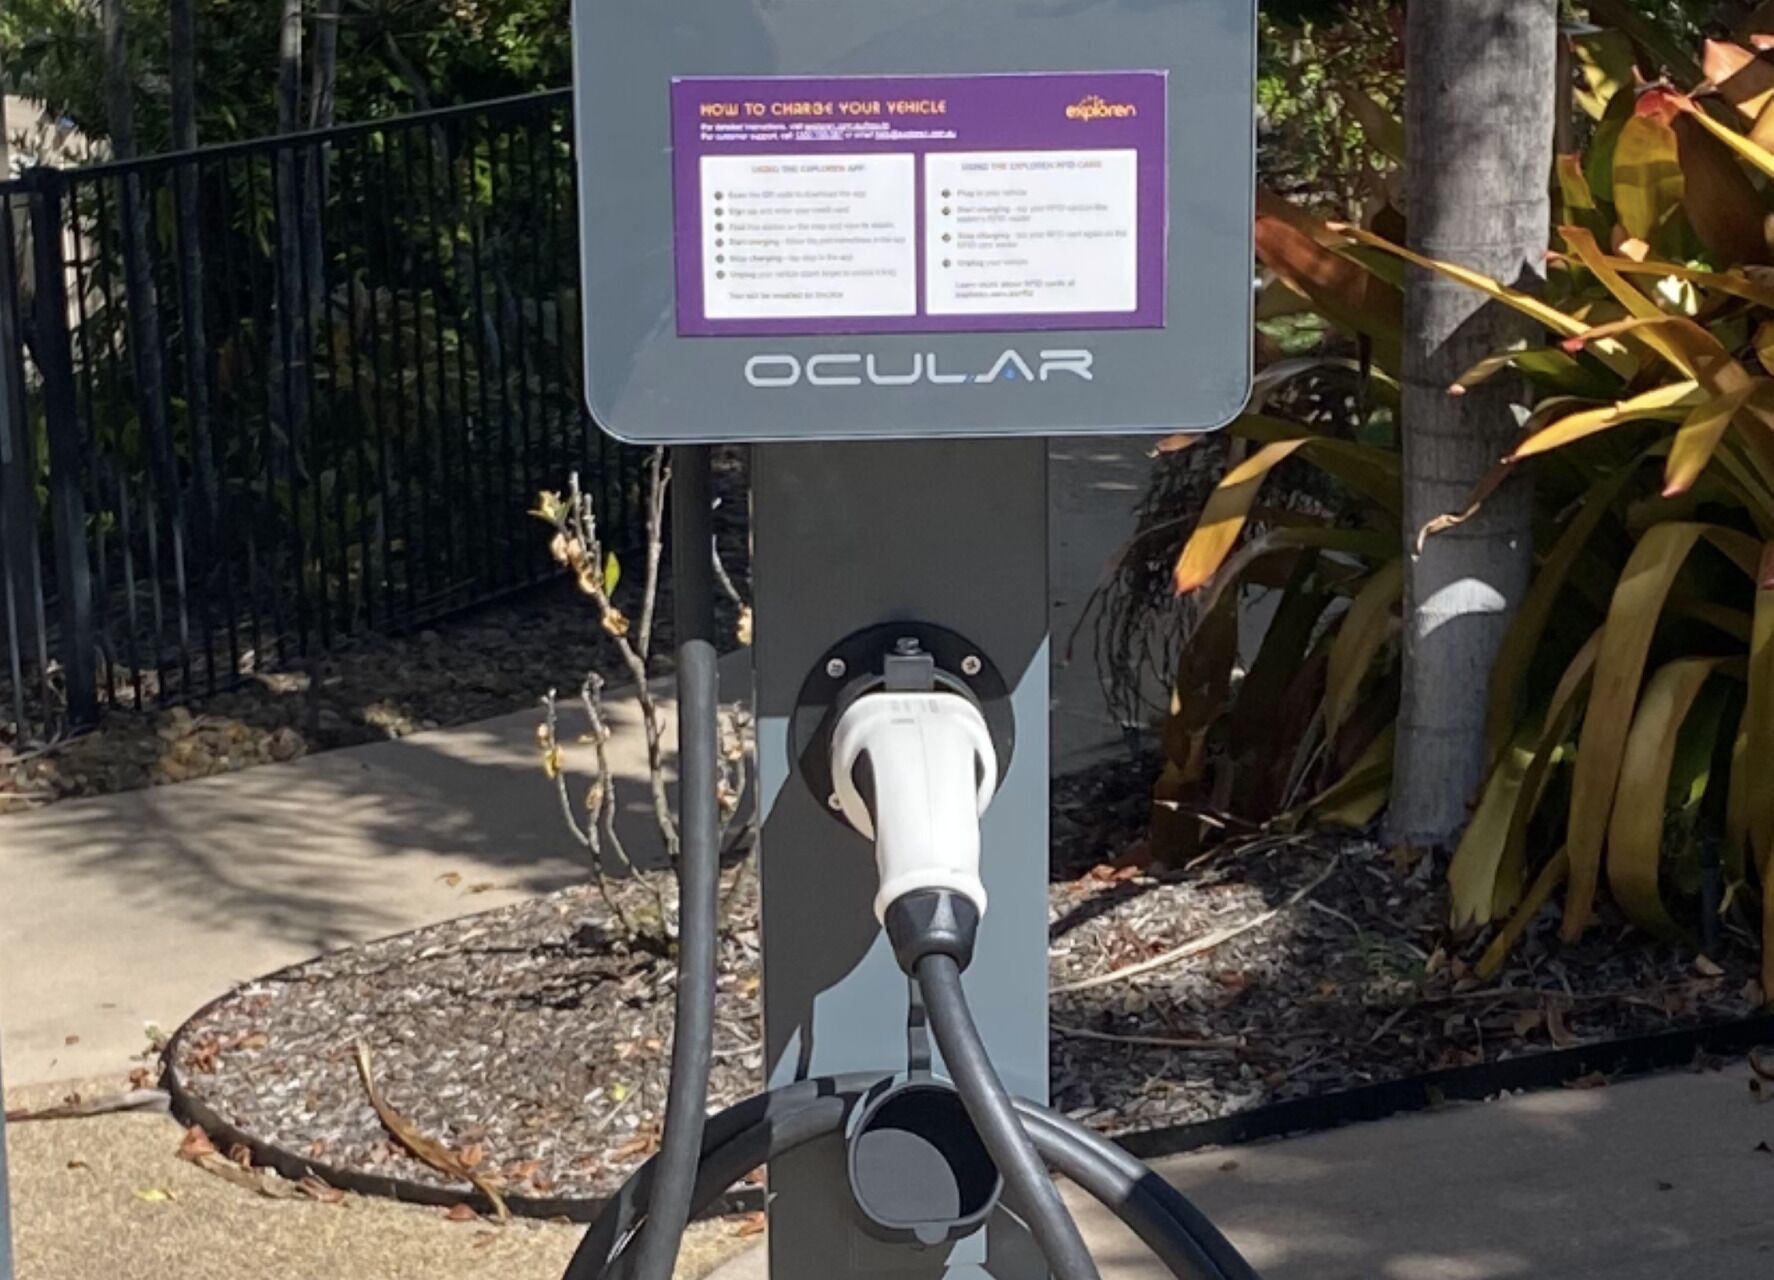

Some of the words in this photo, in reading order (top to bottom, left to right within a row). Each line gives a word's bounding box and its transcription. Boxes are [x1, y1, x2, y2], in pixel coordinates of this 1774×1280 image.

[700, 103, 739, 117] HOW
[743, 102, 766, 116] TO
[771, 102, 834, 116] CHARGE
[838, 101, 881, 115] YOUR
[887, 100, 947, 115] VEHICLE
[1065, 96, 1137, 122] exploren
[744, 349, 1093, 387] OCULAR
